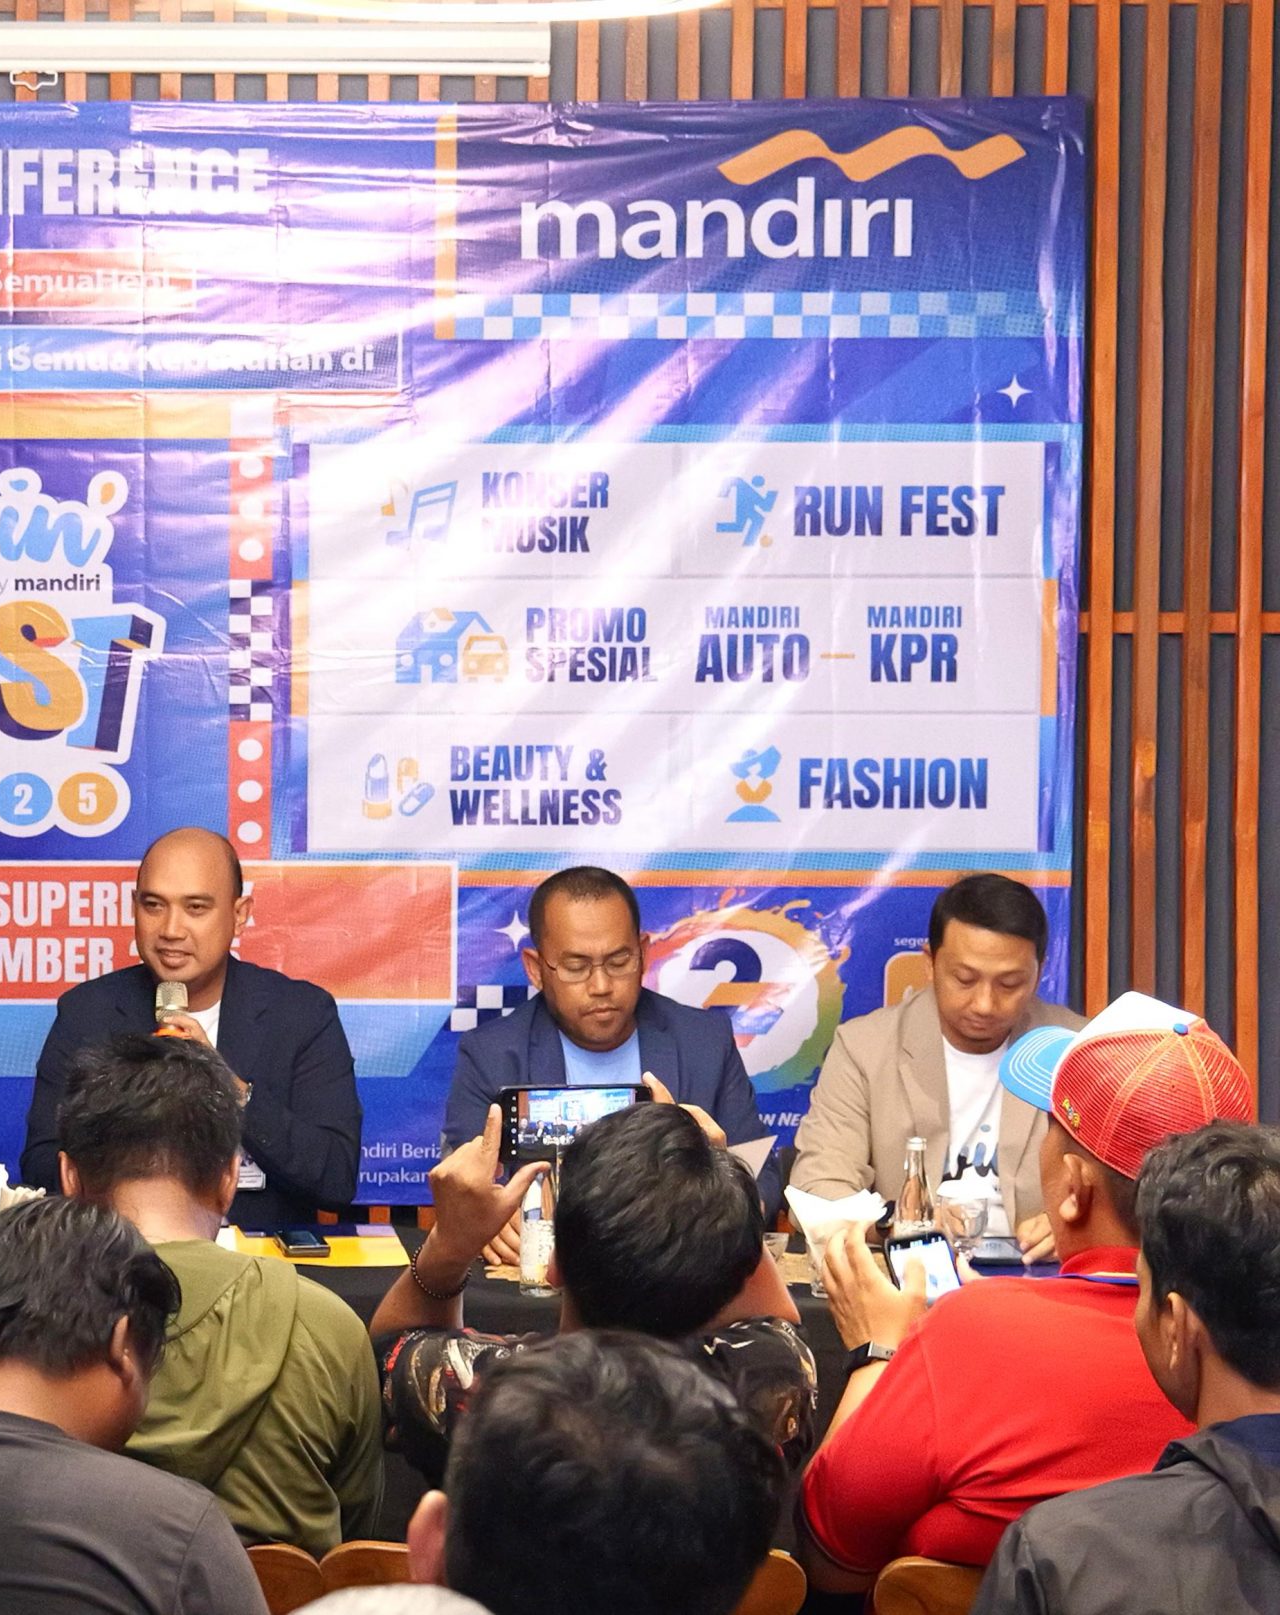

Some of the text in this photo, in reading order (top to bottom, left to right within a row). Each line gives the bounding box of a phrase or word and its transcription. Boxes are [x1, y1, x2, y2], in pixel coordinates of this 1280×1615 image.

[521, 176, 914, 259] mandiri
[11, 345, 129, 372] Semua
[342, 344, 375, 371] di
[793, 485, 1006, 537] RUN FEST
[14, 573, 102, 592] mandiri
[526, 607, 647, 643] PROMO
[704, 606, 800, 629] MANDIRI
[867, 606, 962, 629] MANDIRI
[525, 646, 658, 683] SPESIAL
[695, 634, 811, 683] AUTO
[869, 634, 959, 683] KPR
[450, 745, 608, 783] BEAUTY &
[799, 758, 988, 809] FASHION
[449, 788, 623, 826] WELLNESS
[360, 1142, 442, 1159] ndiri Beriz
